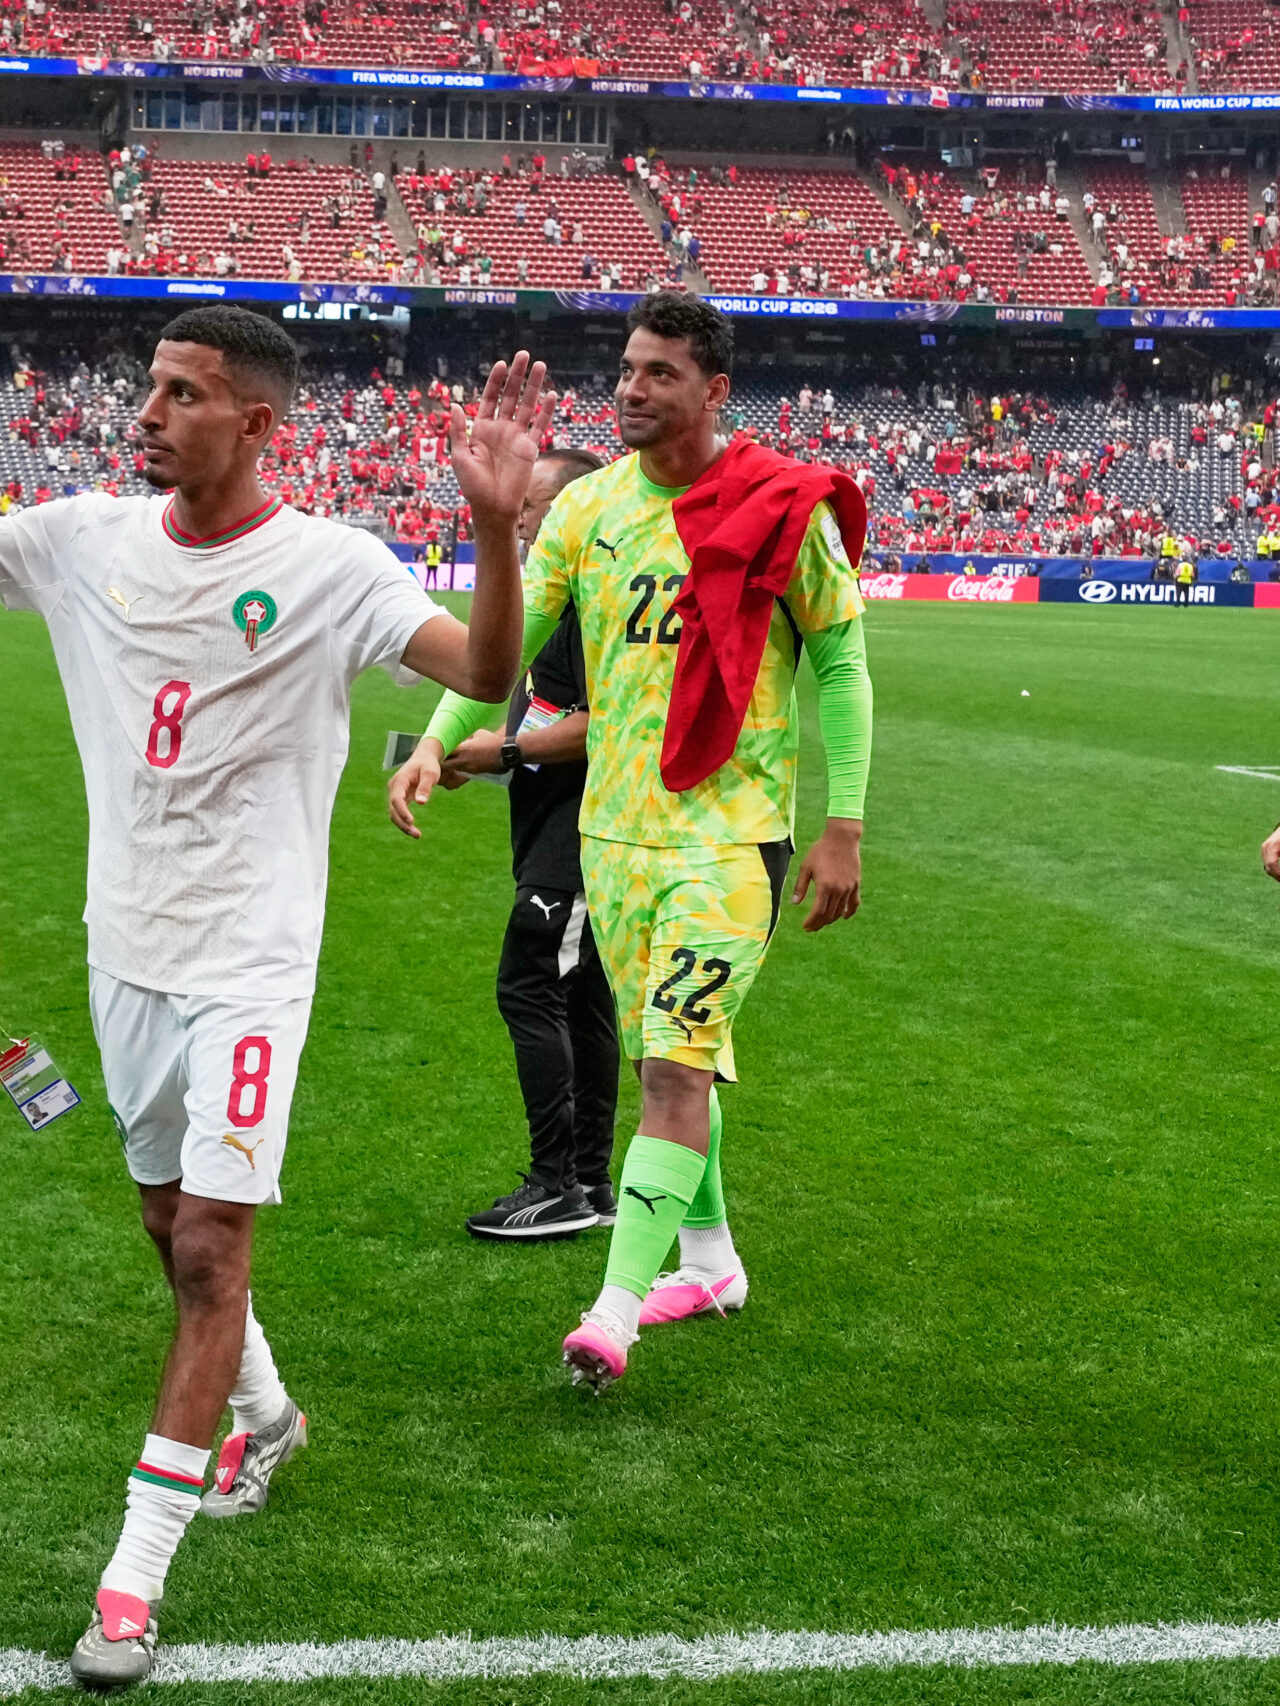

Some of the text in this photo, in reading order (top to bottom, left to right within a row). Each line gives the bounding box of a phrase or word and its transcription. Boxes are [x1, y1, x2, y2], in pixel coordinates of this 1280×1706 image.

[184, 66, 243, 77] HOUSTON
[352, 72, 484, 87] FIFA WORLD CUP 2026
[592, 81, 649, 93] HOUSTON
[986, 97, 1044, 107] HOUSTON
[1155, 98, 1180, 109] FIFA
[1181, 97, 1225, 109] WORLD
[1226, 97, 1251, 108] CUP
[444, 290, 516, 304] HOUSTON
[710, 298, 838, 315] WORLD CUP 2026
[995, 308, 1064, 322] HOUSTON
[626, 574, 688, 644] 22
[145, 680, 192, 768] 8
[651, 947, 733, 1024] 22
[226, 1036, 272, 1127] 8
